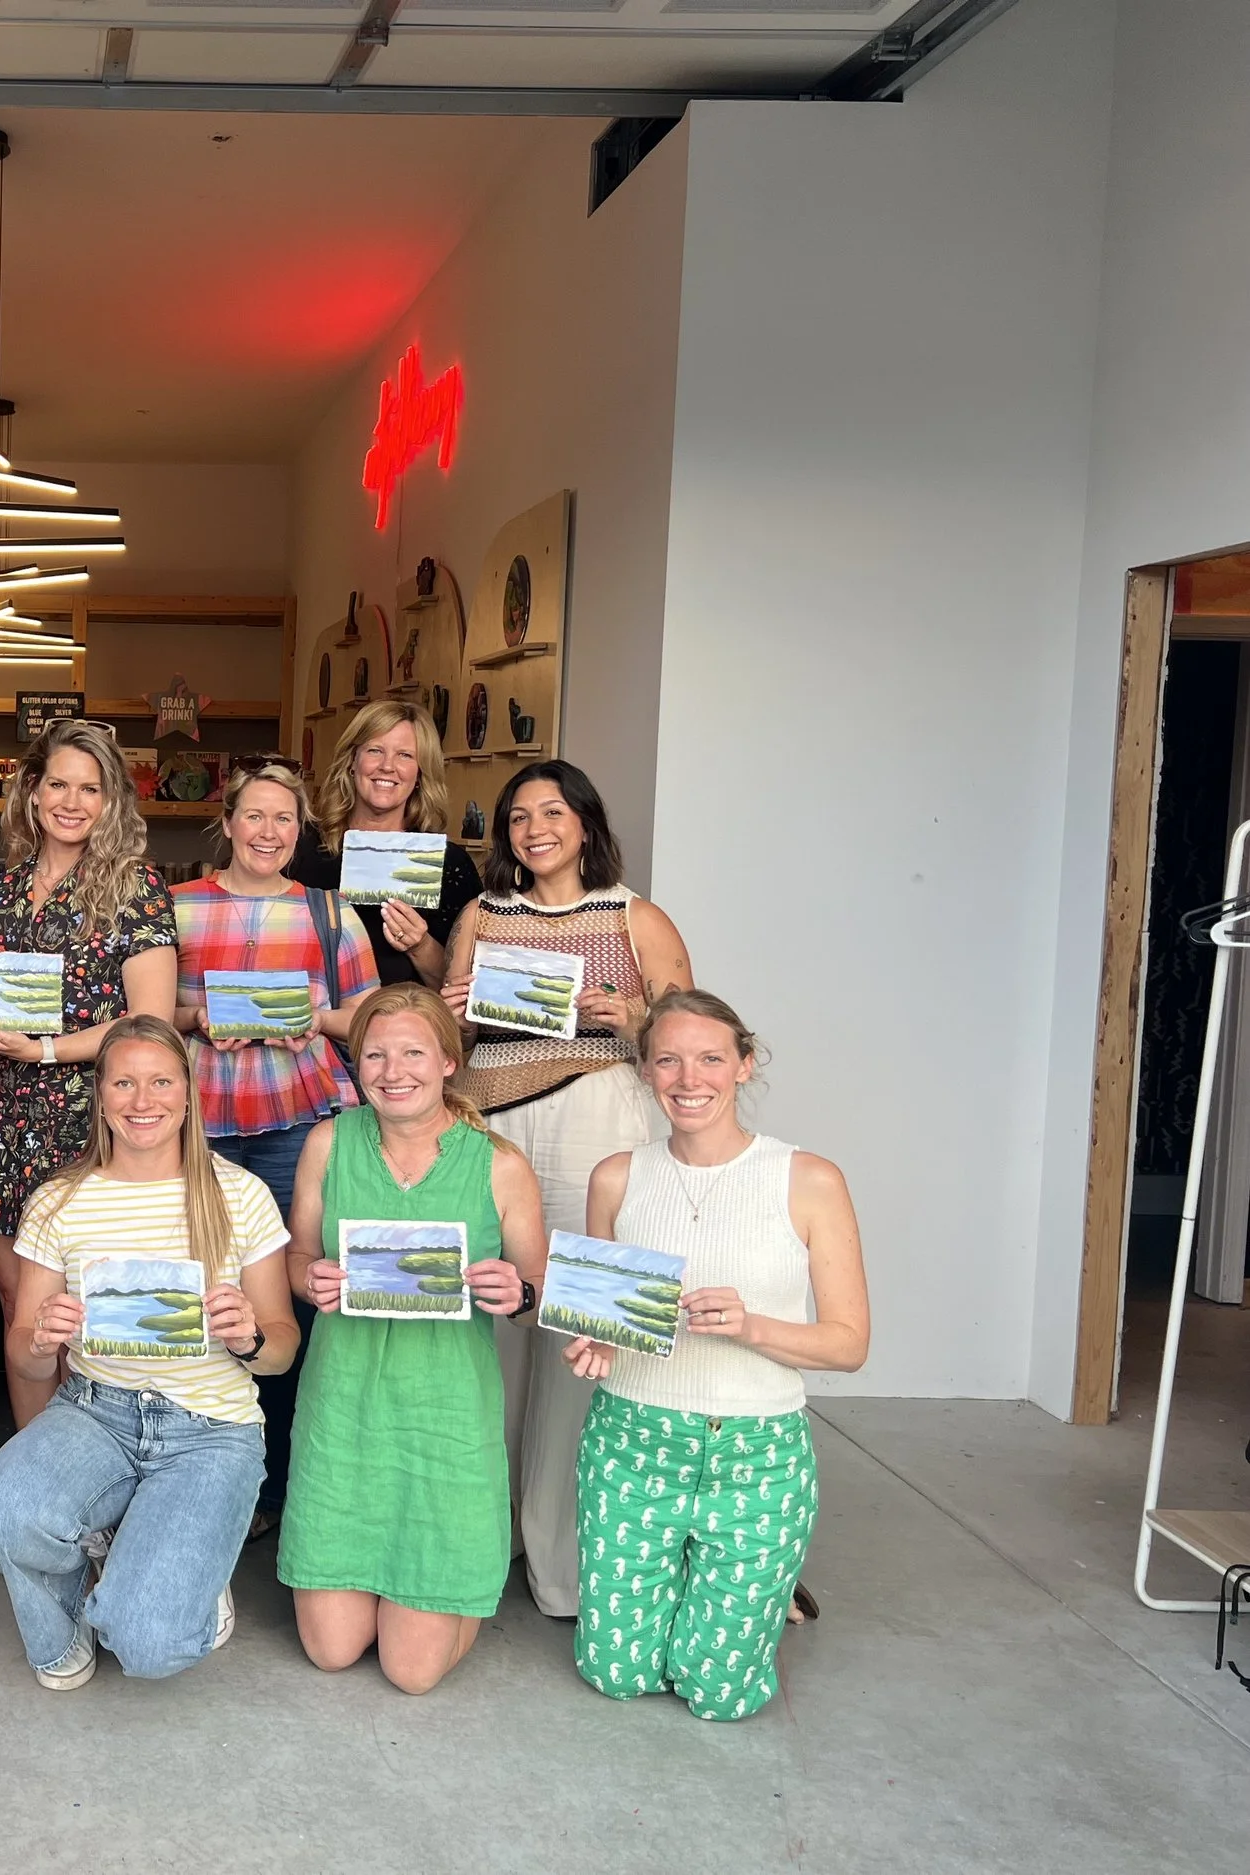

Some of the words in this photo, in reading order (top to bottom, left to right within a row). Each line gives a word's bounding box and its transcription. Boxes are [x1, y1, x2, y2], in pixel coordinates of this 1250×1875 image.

[21, 696, 41, 704] GLITTER
[41, 697, 57, 705] COLOR
[57, 697, 79, 705] OPTIONS
[160, 696, 186, 709] GRAB
[188, 698, 195, 710] A
[29, 709, 42, 717] BLUE
[54, 708, 72, 716] SILVER
[162, 709, 193, 721] DRINK!
[26, 718, 44, 726] GREEN
